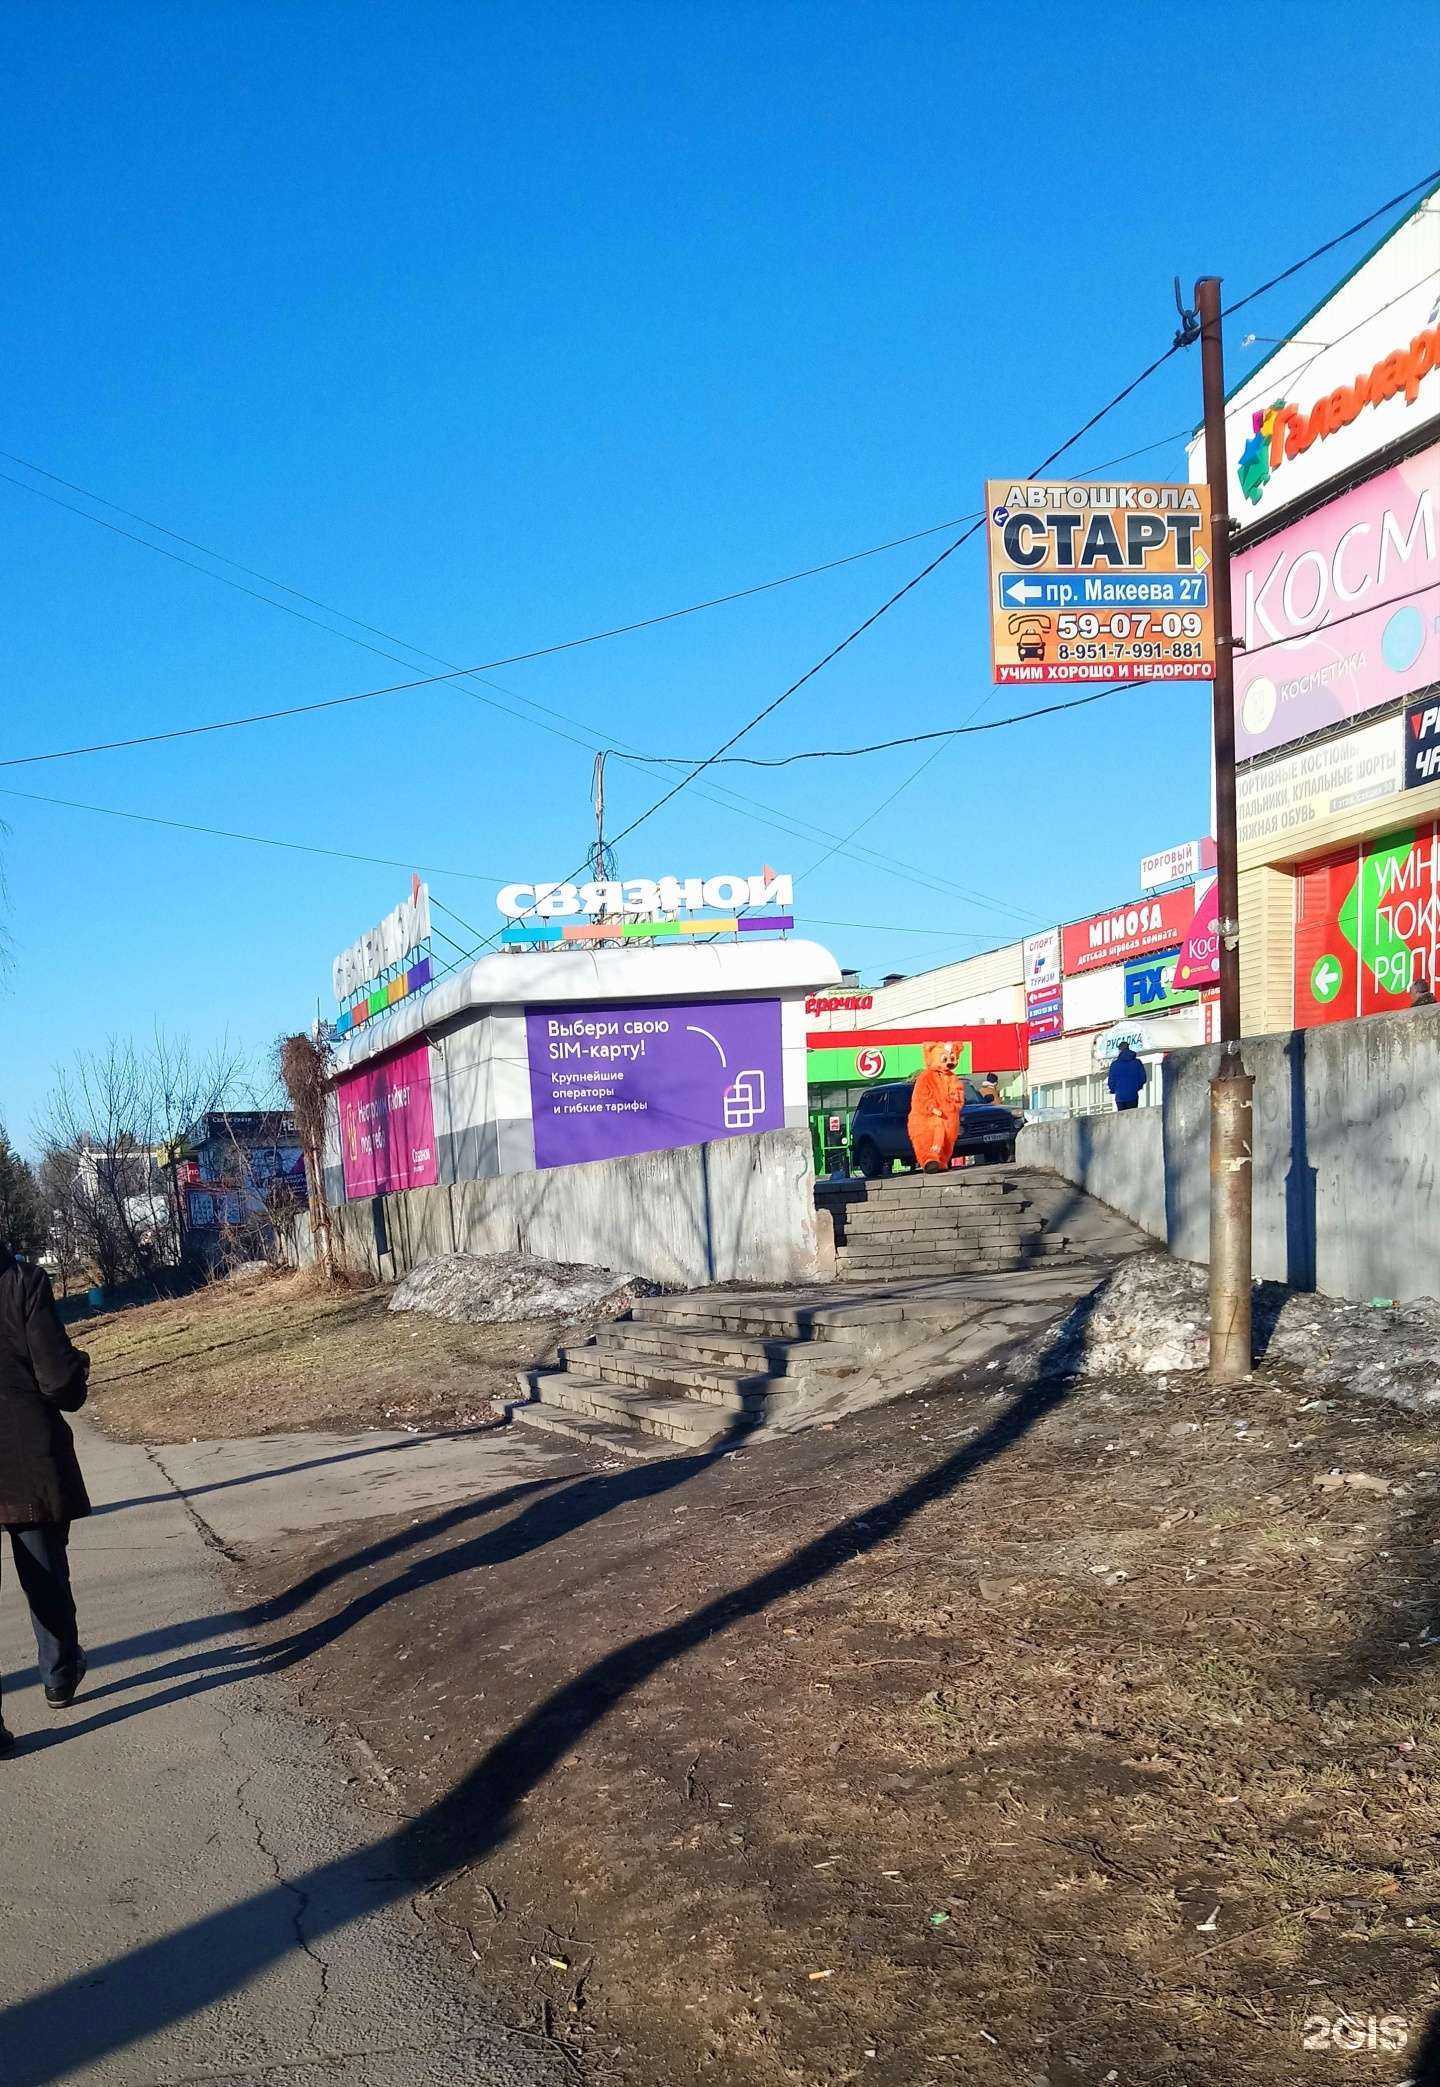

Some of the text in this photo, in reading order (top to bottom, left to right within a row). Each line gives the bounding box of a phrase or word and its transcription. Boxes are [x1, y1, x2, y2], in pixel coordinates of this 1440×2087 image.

[1270, 322, 1440, 472] Галамар
[1004, 486, 1201, 509] АВТОШКОЛА
[1002, 511, 1203, 569] СТАРТ
[1046, 578, 1203, 606] пр. Макеева 27
[1056, 613, 1202, 639] 59-07-09
[1059, 642, 1202, 660] 8-951-7-991-881
[1000, 664, 1212, 681] УЧИМ ХОРОШО И НЕДОРОГО
[1280, 649, 1368, 702] КОСМЕТИКА
[1237, 789, 1291, 820] ПАЛЬНИКИ,
[1359, 750, 1397, 777] ШОРТЫ
[1281, 804, 1316, 830] ОБУВЬ
[1143, 844, 1192, 872] ТОРГОВЫЙ
[1171, 860, 1193, 878] ДОМ
[1089, 903, 1163, 948] MIMOSA
[1029, 936, 1053, 952] СПОРТ
[1030, 973, 1055, 987] ТУРИЗМ
[1125, 966, 1167, 1007] FIX
[548, 1019, 670, 1039] Выбери свою
[549, 1039, 646, 1061] SIM-карту!
[1106, 1033, 1143, 1049] РУСЛКА
[551, 1070, 625, 1085] Крупнейшие
[552, 1088, 615, 1099] операторы
[553, 1100, 648, 1114] и гибкие тарифы
